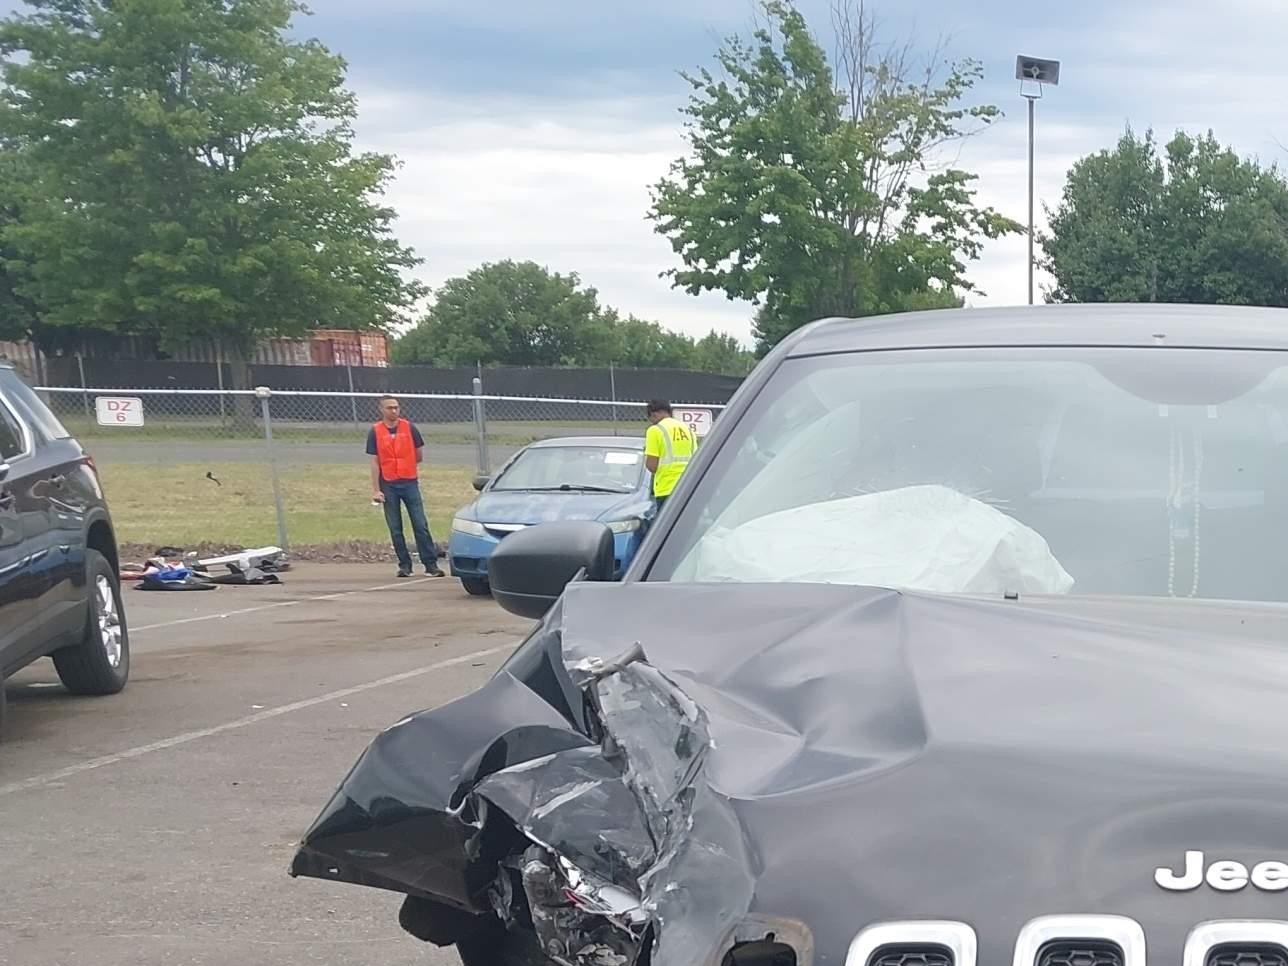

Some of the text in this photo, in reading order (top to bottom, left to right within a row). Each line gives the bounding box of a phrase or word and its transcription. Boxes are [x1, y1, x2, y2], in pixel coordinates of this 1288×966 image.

[107, 401, 132, 411] DZ
[116, 412, 126, 422] 6
[682, 413, 704, 422] DZ
[689, 423, 697, 432] 8
